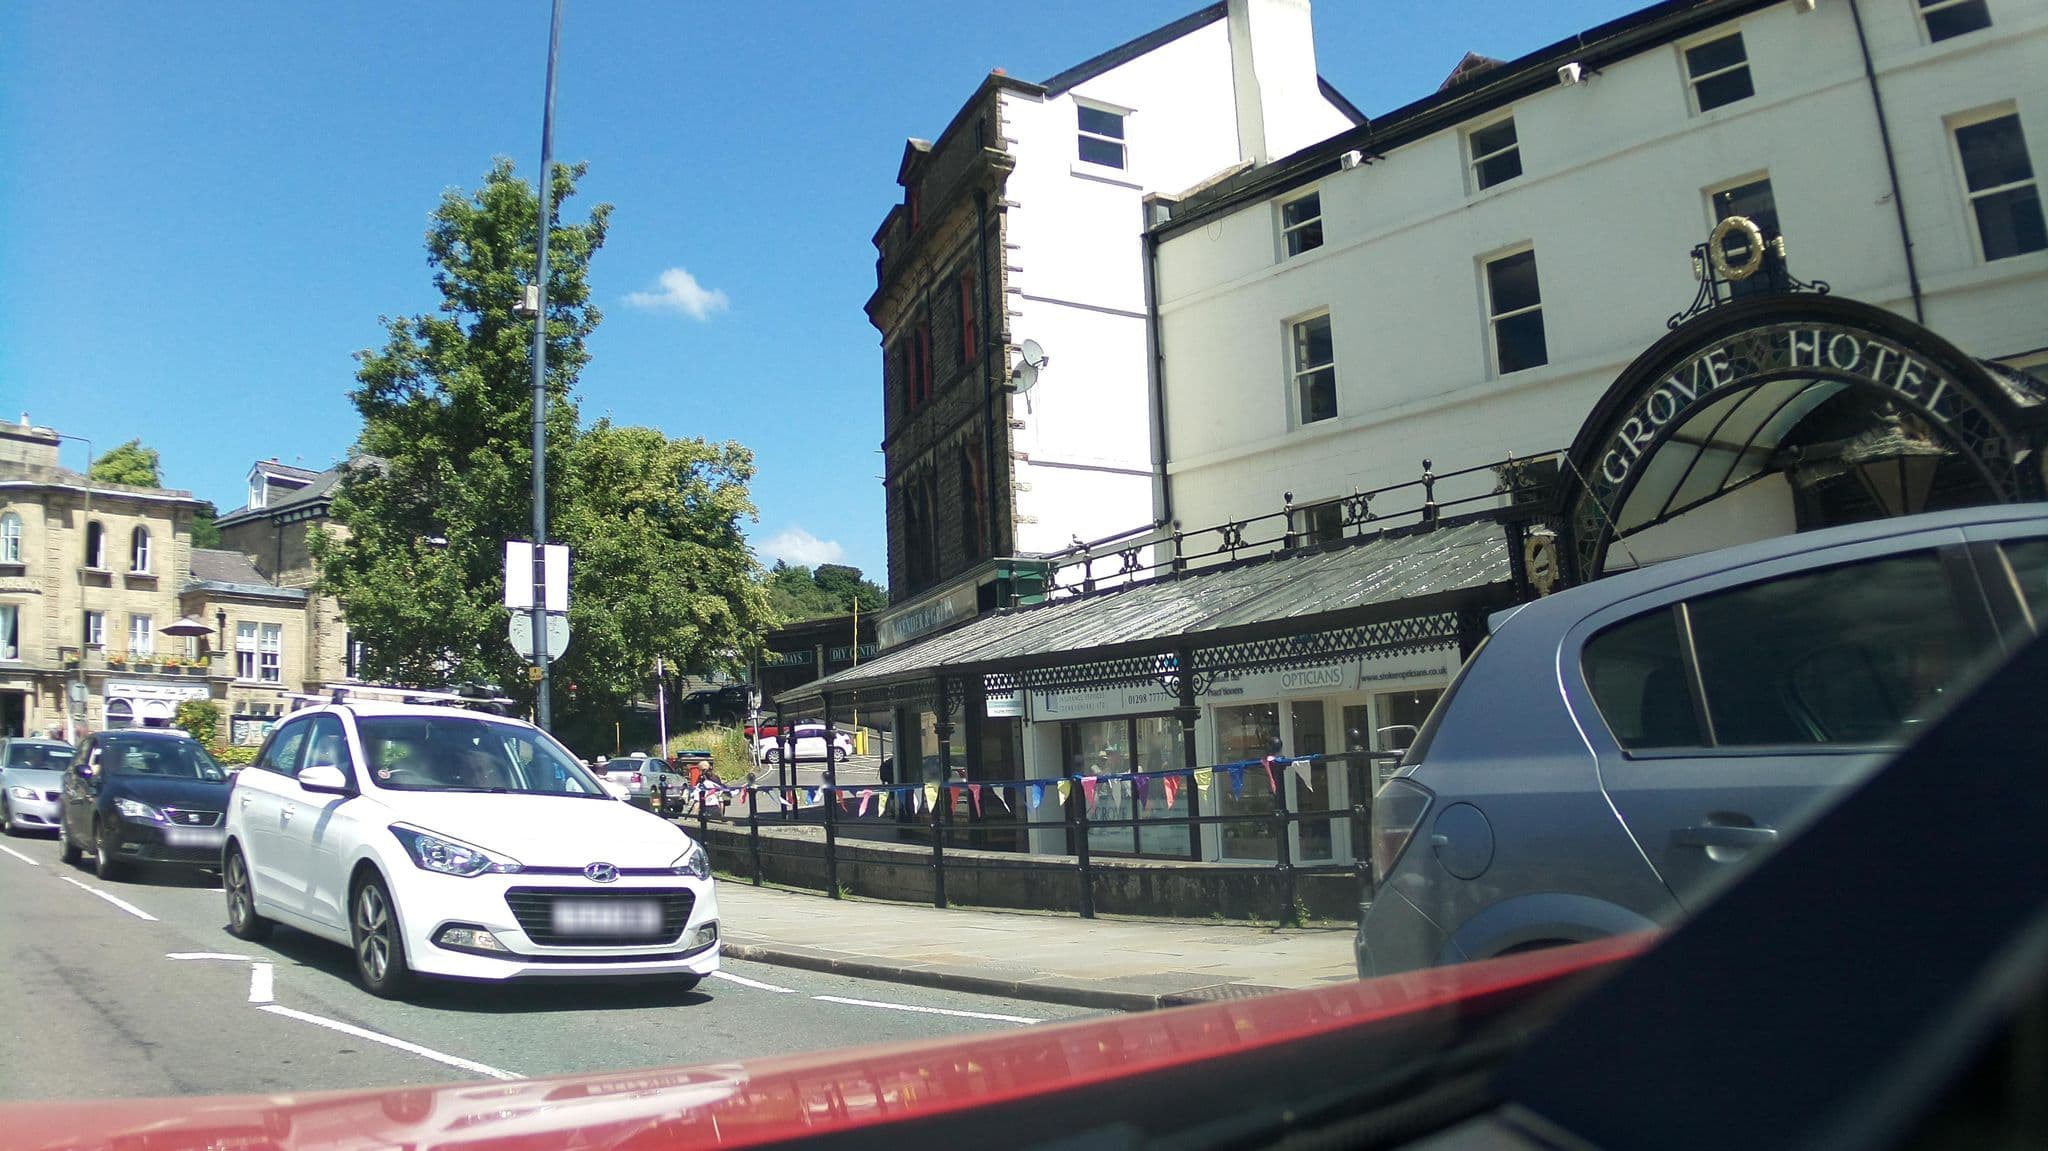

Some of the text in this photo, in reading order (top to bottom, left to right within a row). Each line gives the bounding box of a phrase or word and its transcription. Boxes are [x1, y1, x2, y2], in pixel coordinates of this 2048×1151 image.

[1602, 329, 1954, 484] GROVE HOTEL
[832, 648, 848, 660] DIY
[1281, 667, 1341, 688] OPTICIANS
[1128, 694, 1147, 705] 01298
